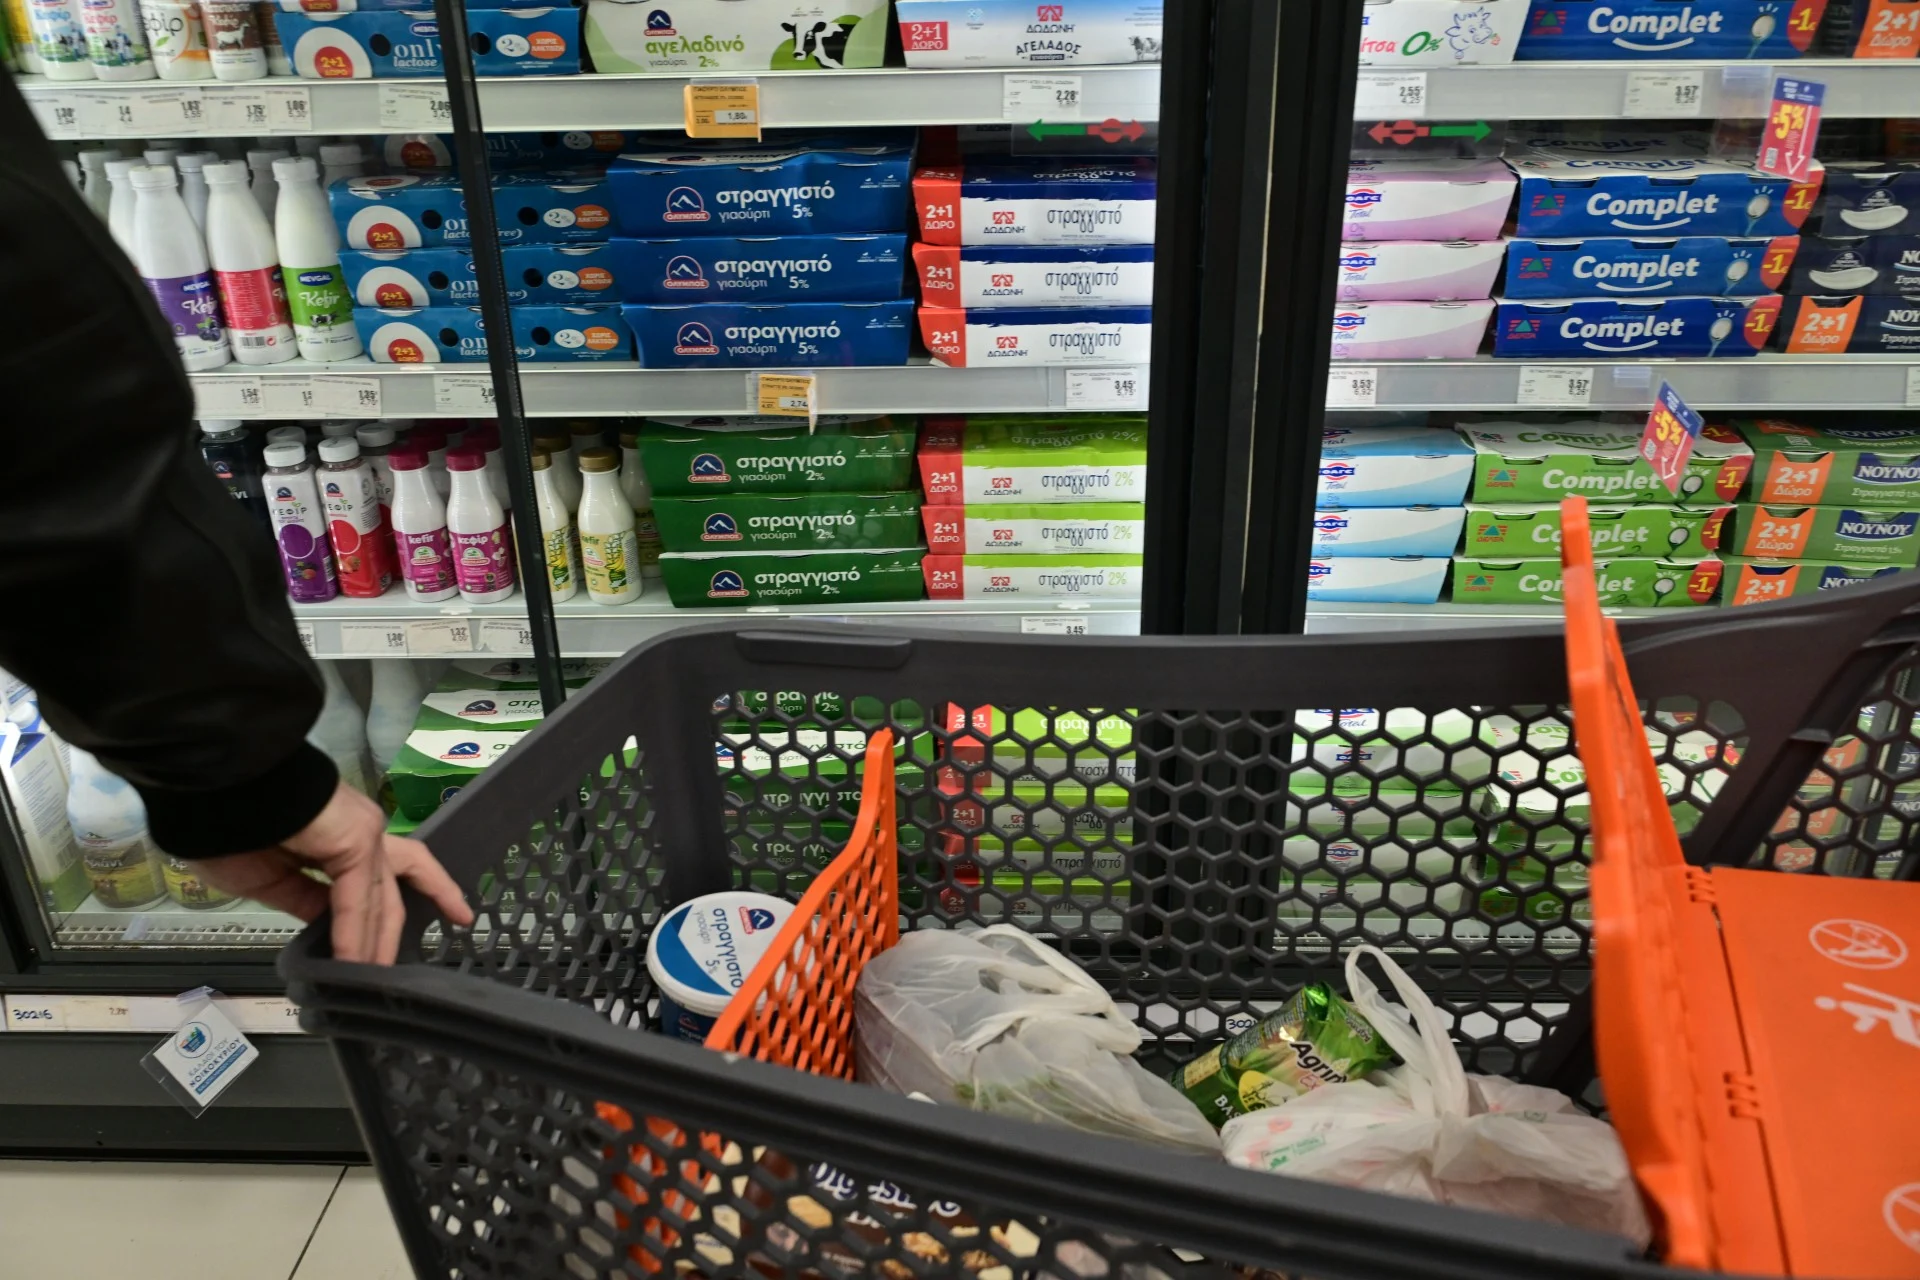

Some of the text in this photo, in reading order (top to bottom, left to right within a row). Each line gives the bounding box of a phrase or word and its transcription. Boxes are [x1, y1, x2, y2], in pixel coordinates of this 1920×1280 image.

[1588, 7, 1723, 40] Complet
[1872, 9, 1920, 31] 2+1
[911, 24, 942, 40] 2+1
[1026, 24, 1074, 33] ΔΩΔΩΝΗ
[394, 38, 443, 58] onl
[645, 35, 744, 57] αγελαδινό
[911, 41, 944, 50] ΔΩΡΟ
[1016, 40, 1082, 56] ΑΓΕΛΑΔΟΣ
[1402, 31, 1443, 56] 0%
[1869, 33, 1912, 48] Δώρο
[320, 57, 345, 69] 2+1
[393, 57, 437, 67] lactose
[649, 55, 719, 67] γιαούρτι 2%
[716, 181, 835, 207] στραγγιστό
[719, 204, 813, 222] γιαούρτι 5%
[926, 205, 952, 218] 2+1
[1586, 191, 1719, 220] Complet
[925, 220, 955, 229] ΔΩΡΟ
[1047, 203, 1122, 233] στραγγιστό
[983, 226, 1025, 234] ΔΩΔΩΝΗ
[714, 254, 832, 277] στραγγιστό
[927, 266, 952, 279] 2+1
[1573, 254, 1699, 283] Complet
[716, 277, 810, 291] γιαούρτι 5%
[925, 281, 954, 290] ΔΩΡΟ
[1045, 266, 1119, 295] στραγγιστό
[298, 291, 340, 308] Kefir
[982, 288, 1023, 296] ΔΩΔΩΝΗ
[1560, 316, 1685, 342] Complet
[1803, 313, 1847, 332] 2+1
[724, 321, 841, 344] στραγγιστό
[932, 331, 957, 344] 2+1
[1800, 333, 1840, 345] Δώρο
[1049, 327, 1121, 355] στραγγιστό
[727, 342, 818, 356] γιαούρτι 5%
[932, 346, 960, 354] ΔΩΡΟ
[736, 451, 847, 472] στραγγιστό
[739, 470, 825, 483] γιαούρτι 2%
[931, 472, 955, 484] 2+1
[1041, 469, 1134, 495] στραγγιστό 2%
[1542, 469, 1660, 495] Complet
[1776, 467, 1819, 484] 2+1
[929, 485, 957, 493] ΔΩΡΟ
[983, 488, 1022, 496] ΔΩΔΩΝΗ
[1773, 485, 1813, 497] Δώρο
[748, 510, 856, 529] στραγγιστό
[750, 528, 835, 541] γιαούρτι 2%
[934, 523, 958, 533] 2+1
[1041, 523, 1132, 547] στραγγιστό 2%
[1531, 523, 1649, 547] Coplet
[1758, 523, 1802, 538] 2+1
[408, 534, 434, 544] kefir
[932, 535, 960, 543] ΔΩΡΟ
[1756, 538, 1794, 551] Δώρο
[754, 567, 860, 587] στραγγιστό
[932, 570, 957, 581] 2+1
[1038, 570, 1127, 592] στραγγιστό 2%
[756, 585, 840, 598] γιαούρτι 2%
[932, 582, 958, 590] ΔΩΡΟ
[1745, 579, 1787, 595] 2+1
[1066, 625, 1084, 635] 3.45
[821, 702, 840, 712] 2%
[190, 1038, 240, 1088] ΝΟΙΚΟΚΥΡΙΟΥ
